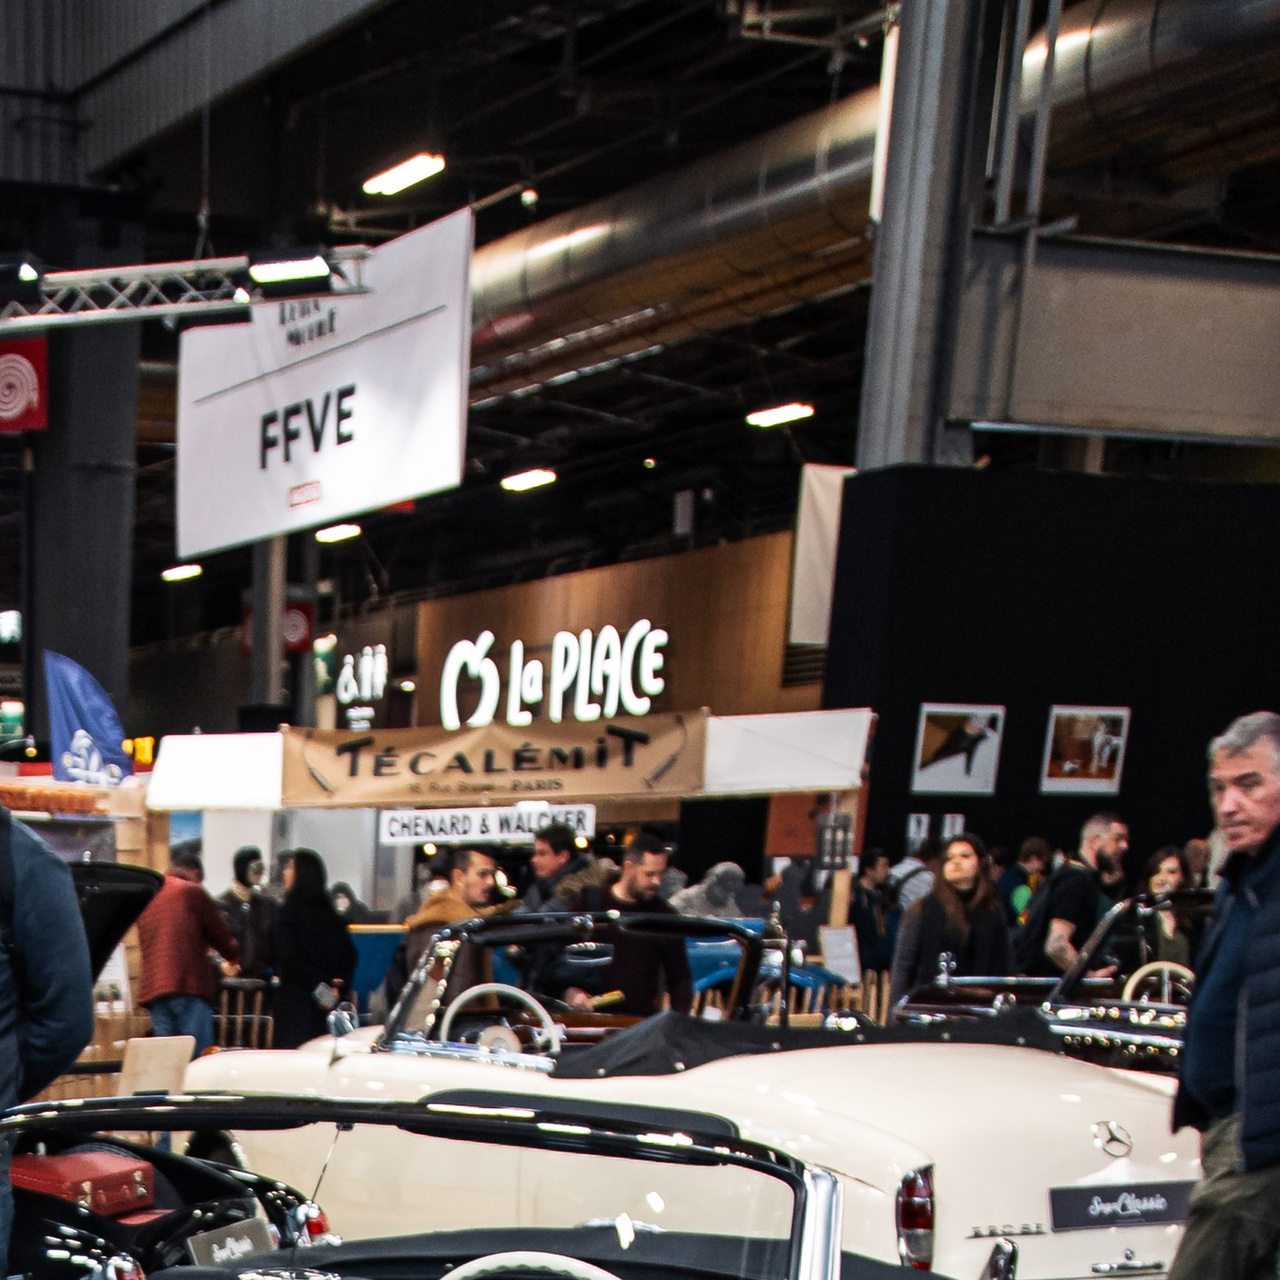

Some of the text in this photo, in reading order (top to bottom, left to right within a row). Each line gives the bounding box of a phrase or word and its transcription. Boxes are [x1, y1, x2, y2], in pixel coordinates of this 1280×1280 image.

[259, 384, 355, 470] FFVE
[387, 815, 472, 838] CHENARD
[479, 817, 489, 835] &
